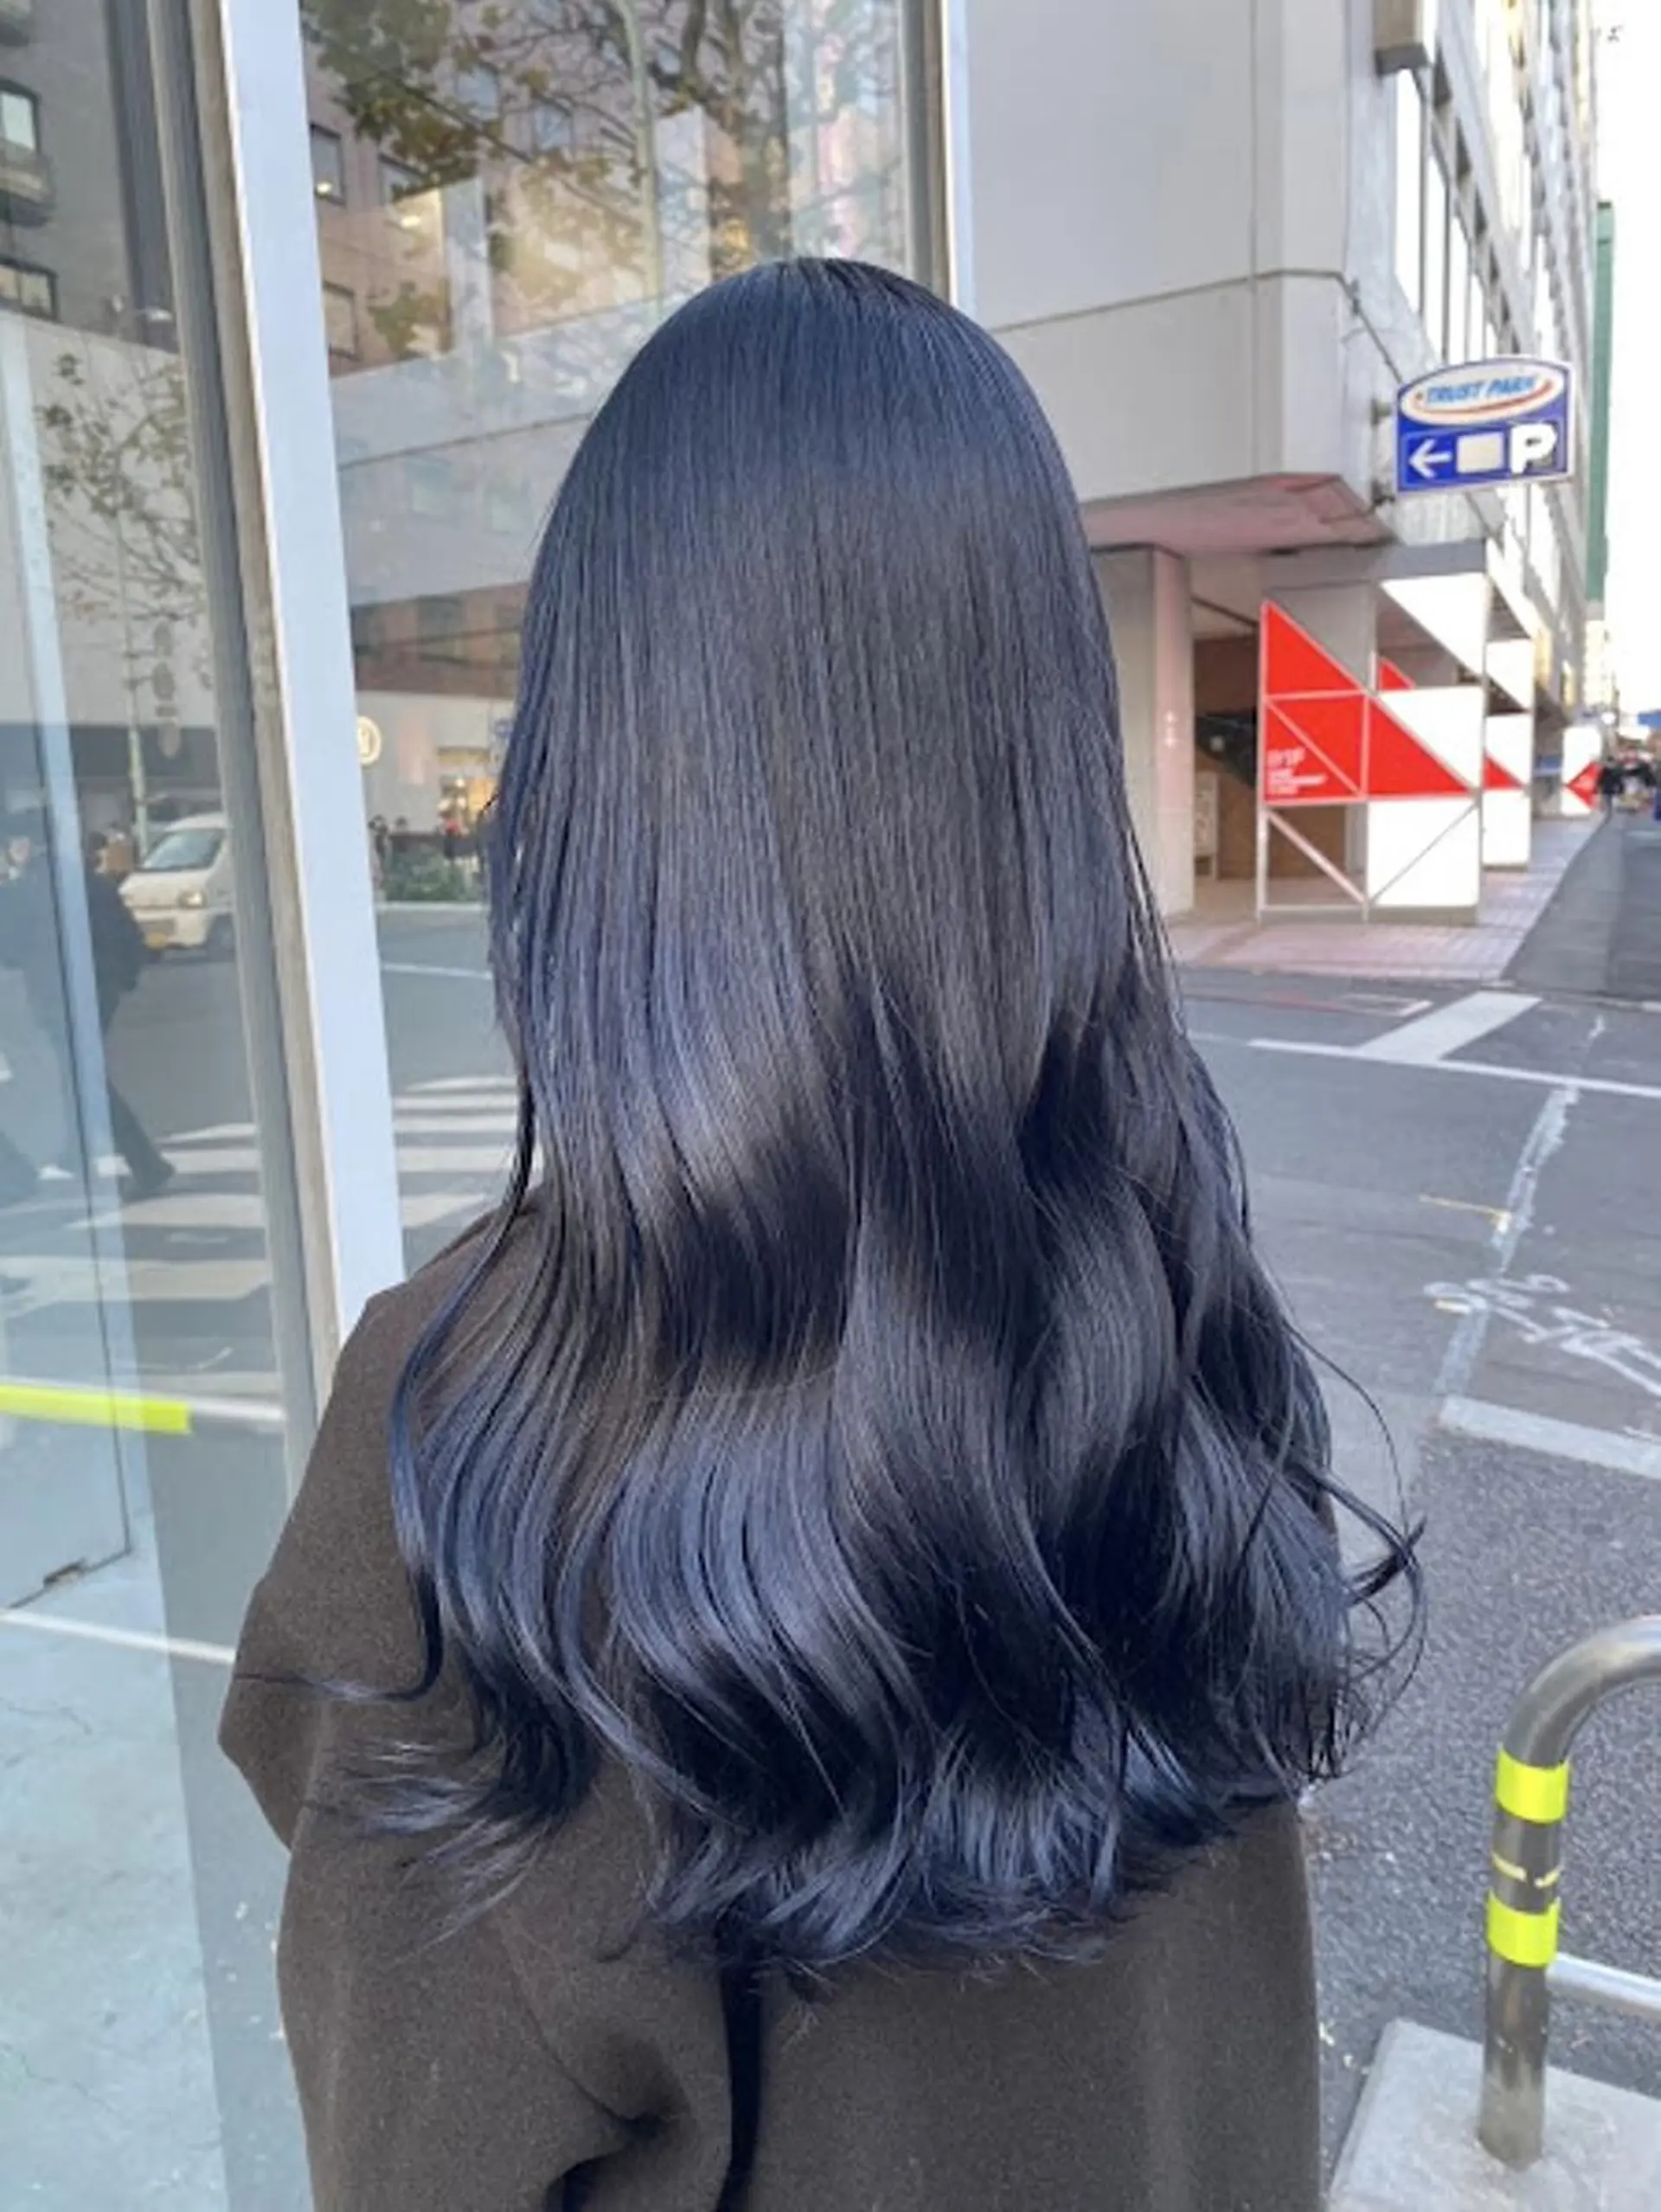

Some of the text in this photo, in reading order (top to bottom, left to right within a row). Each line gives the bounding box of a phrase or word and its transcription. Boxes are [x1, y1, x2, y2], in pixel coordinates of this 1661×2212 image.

[1426, 374, 1539, 405] TRUST PARK
[1510, 422, 1557, 474] P
